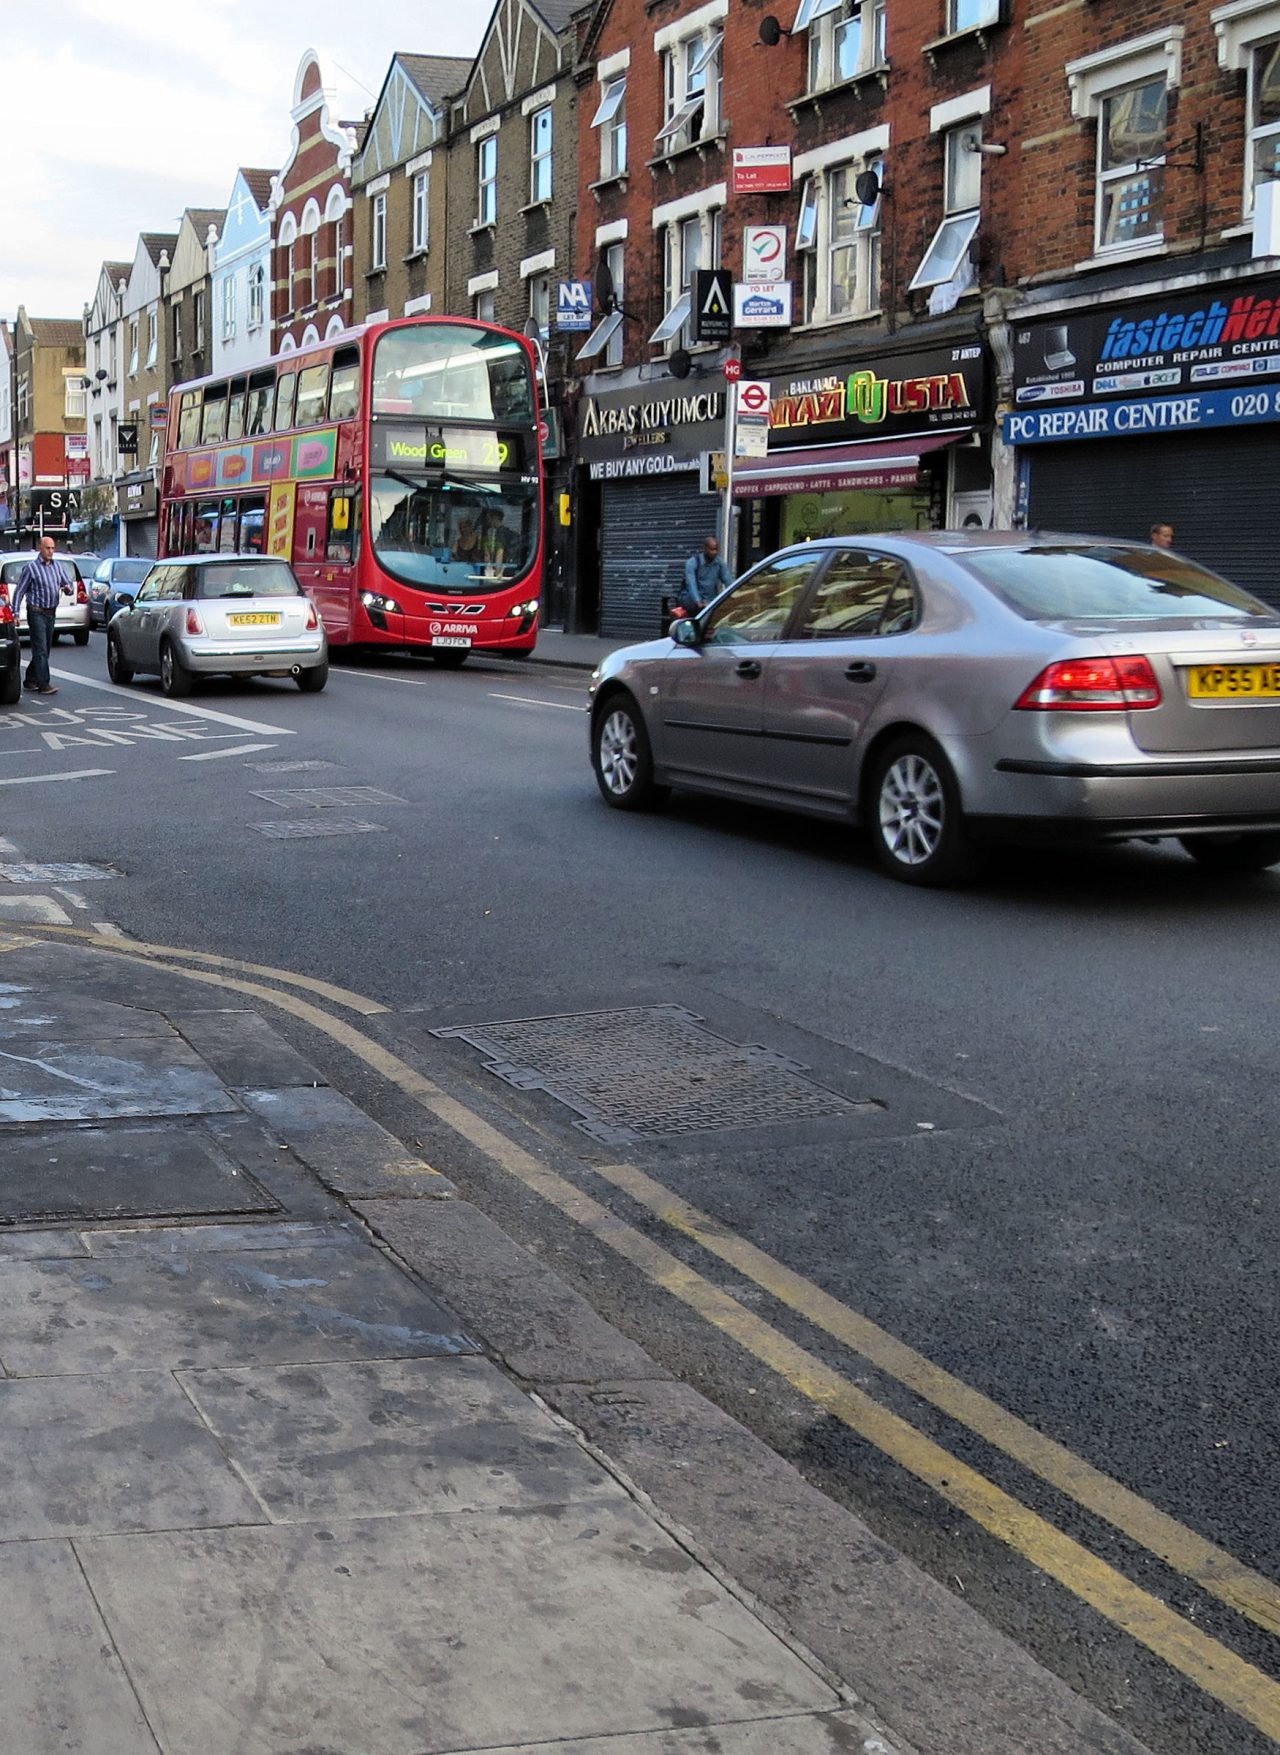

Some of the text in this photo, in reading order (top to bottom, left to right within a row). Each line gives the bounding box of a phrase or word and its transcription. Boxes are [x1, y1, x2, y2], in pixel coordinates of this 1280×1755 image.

[559, 283, 589, 307] NA
[1095, 339, 1280, 373] COMPUTER REPAIR CENTR
[725, 365, 740, 375] HG
[888, 373, 970, 414] USTA
[1050, 384, 1082, 395] TOSHIBA
[641, 391, 718, 430] KUYUMCU
[1009, 416, 1035, 439] PC
[1038, 409, 1109, 437] REPAIR
[1114, 398, 1201, 429] CENTRE
[1231, 393, 1269, 417] 020
[623, 431, 666, 450] JEWELLERS
[390, 441, 509, 465] Wood Green 29
[590, 463, 604, 480] WE
[606, 459, 625, 478] BUY
[625, 458, 646, 475] ANY
[646, 455, 675, 474] GOLD
[735, 484, 760, 494] COFFEE
[764, 481, 805, 493] CAPPUCCINO
[809, 478, 831, 489] LATTE
[837, 475, 884, 488] SANDWICHES
[442, 624, 478, 634] ARRIVA
